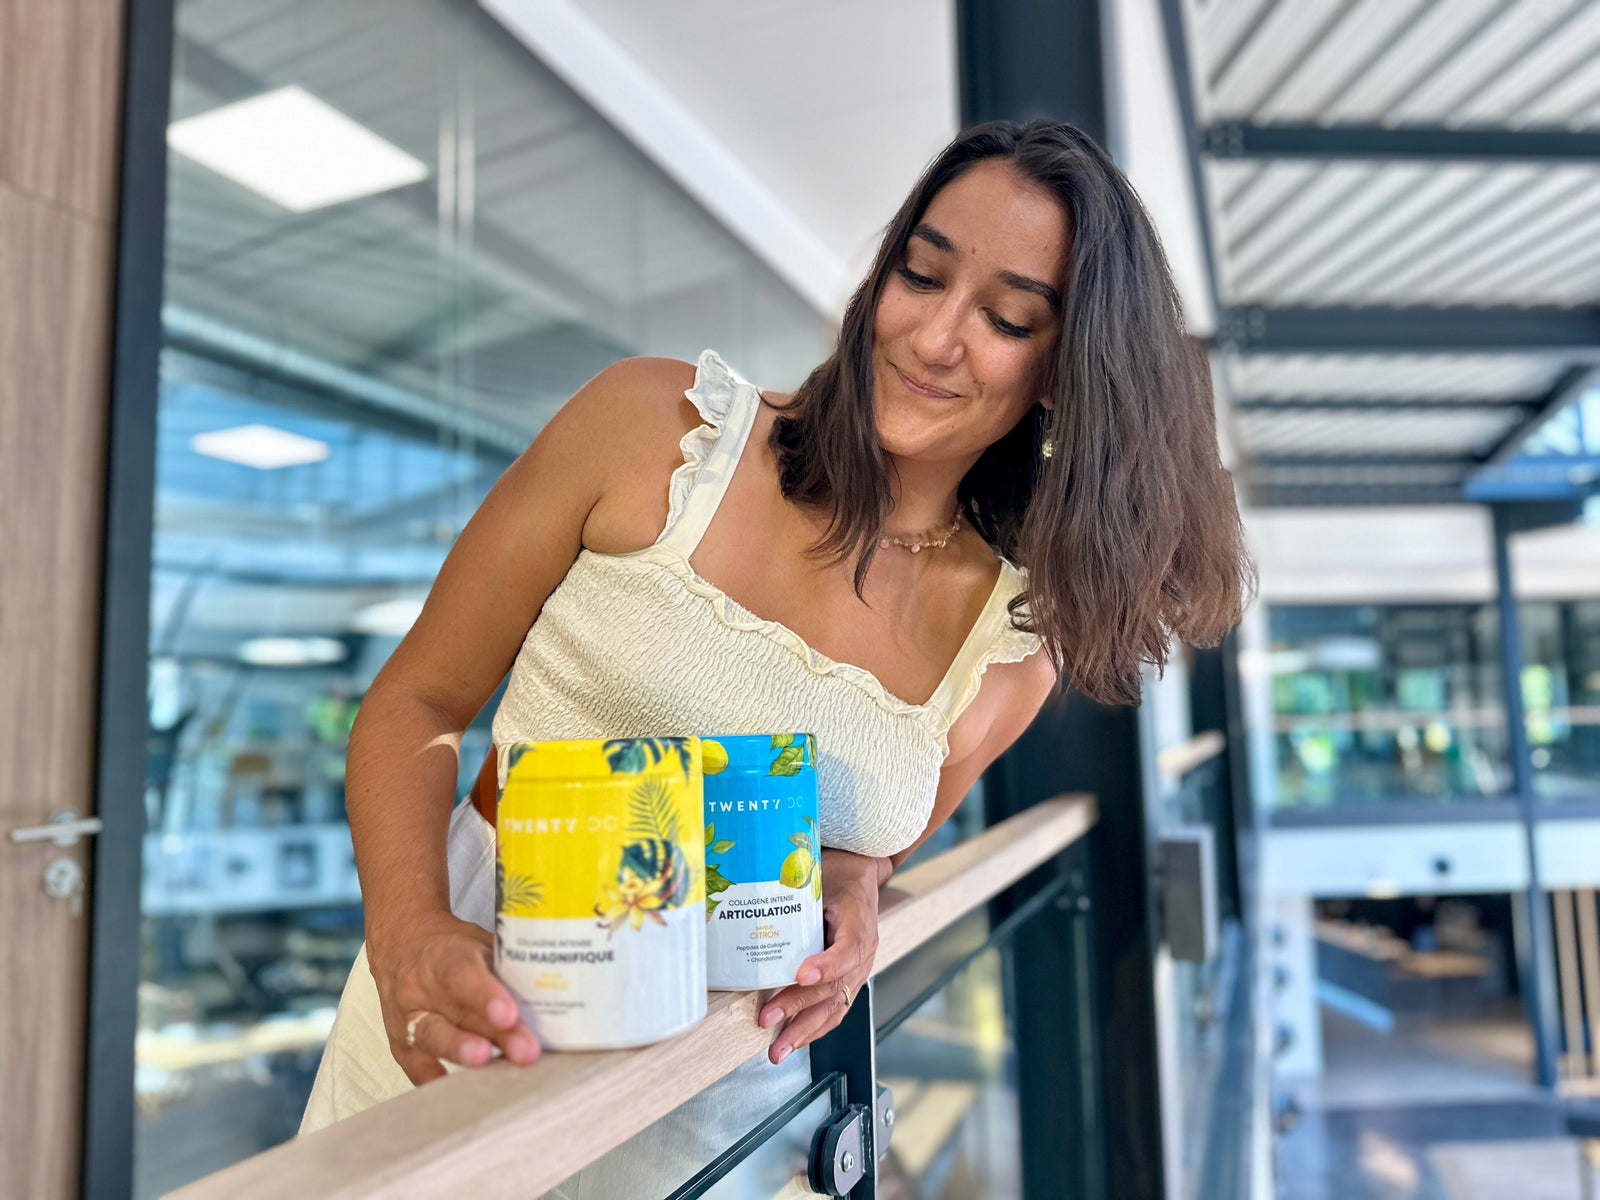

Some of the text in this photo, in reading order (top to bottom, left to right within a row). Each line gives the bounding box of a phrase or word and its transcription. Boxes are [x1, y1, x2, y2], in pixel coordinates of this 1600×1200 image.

[708, 798, 780, 812] TWENTY
[504, 818, 577, 834] TWENTY
[728, 894, 794, 906] COLLAGÈNE INTENSE
[718, 904, 802, 920] ARTICULATIONS
[750, 930, 779, 940] CITRON
[529, 950, 614, 964] MAGNIFIQUE
